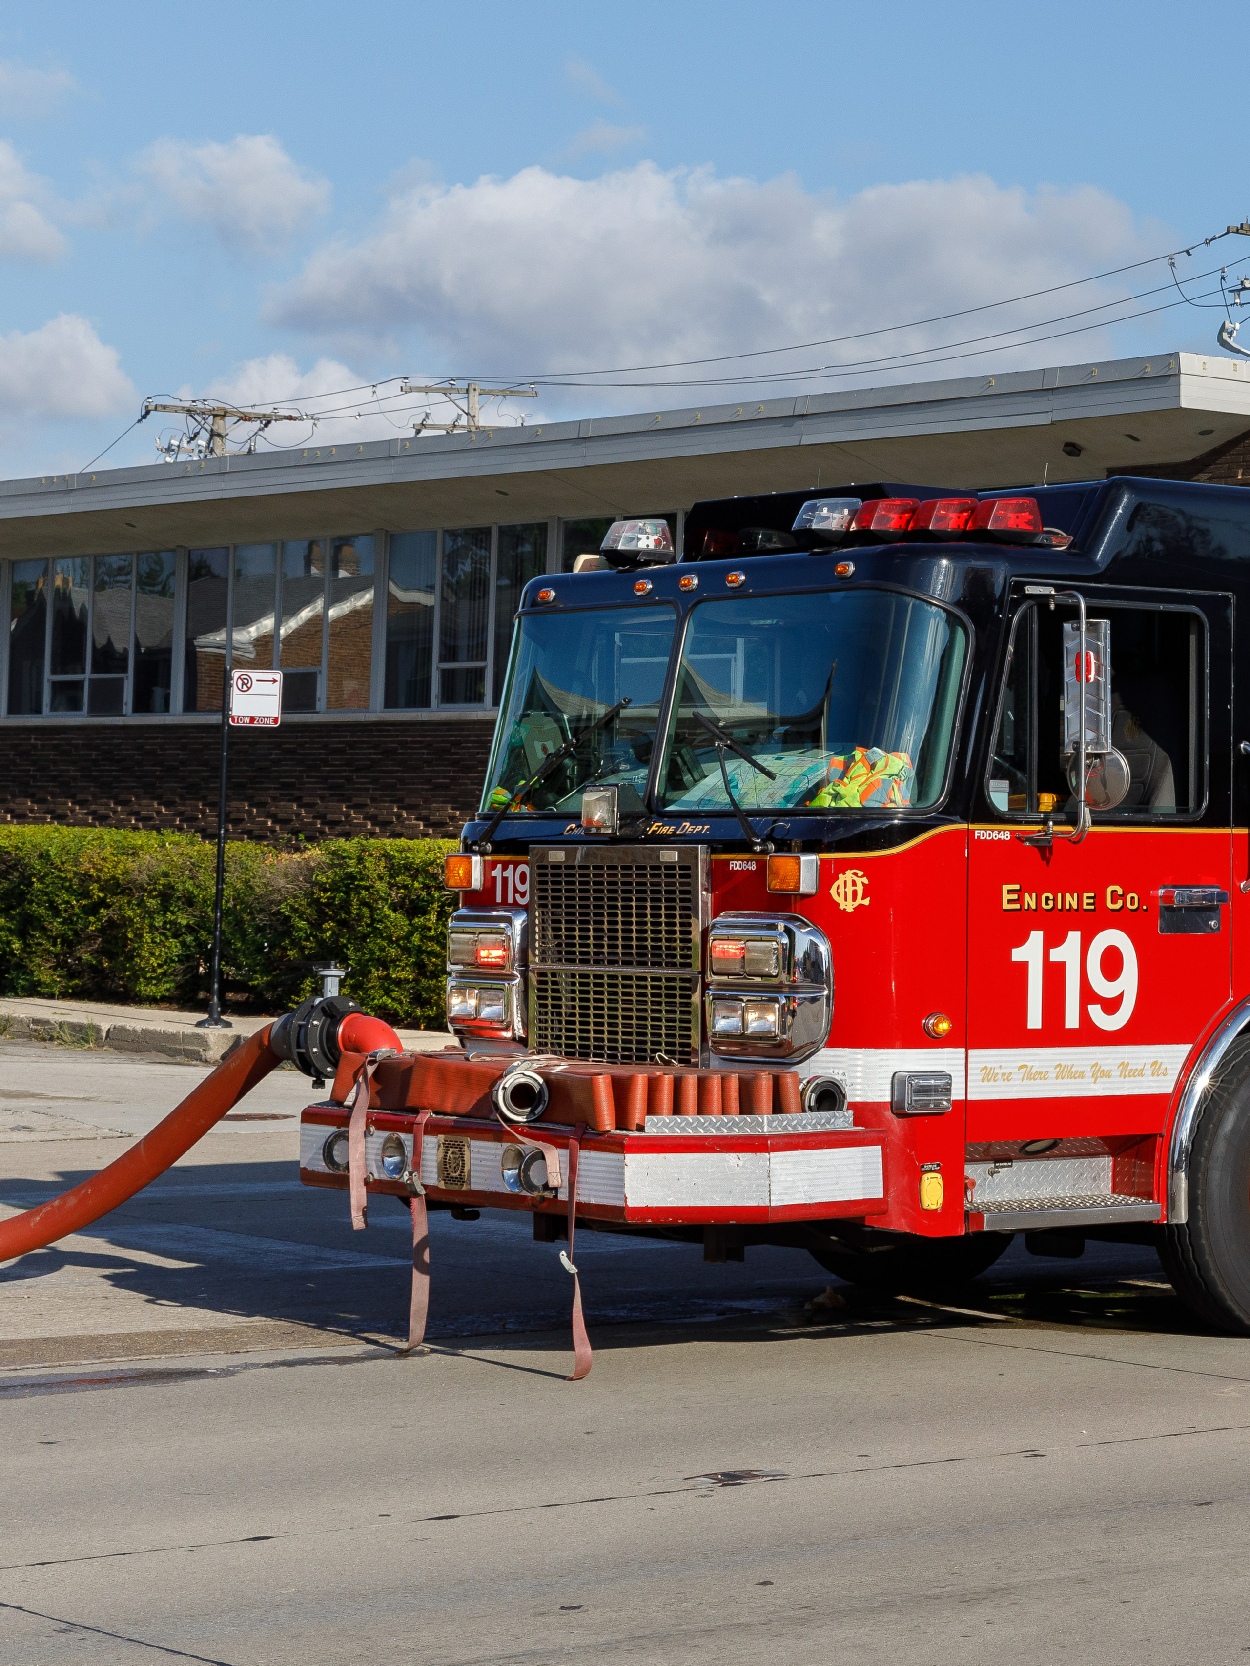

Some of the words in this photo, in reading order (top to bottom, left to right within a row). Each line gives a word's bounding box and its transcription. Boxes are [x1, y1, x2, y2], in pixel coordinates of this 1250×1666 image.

[233, 716, 250, 724] TOW
[253, 716, 275, 725] ZONE
[647, 822, 676, 835] FIRE
[676, 822, 711, 835] DEPT.
[974, 830, 1011, 841] FDD648
[729, 860, 757, 871] FDD648
[491, 863, 530, 905] 119
[1002, 884, 1096, 912] ENGINE
[1105, 885, 1149, 912] CO.
[1011, 928, 1139, 1032] 119
[979, 1064, 1013, 1083] We're
[1017, 1063, 1049, 1082] There
[1053, 1062, 1086, 1081] When
[1089, 1061, 1112, 1084] You
[1116, 1060, 1147, 1079] Need
[1149, 1060, 1169, 1077] Us
